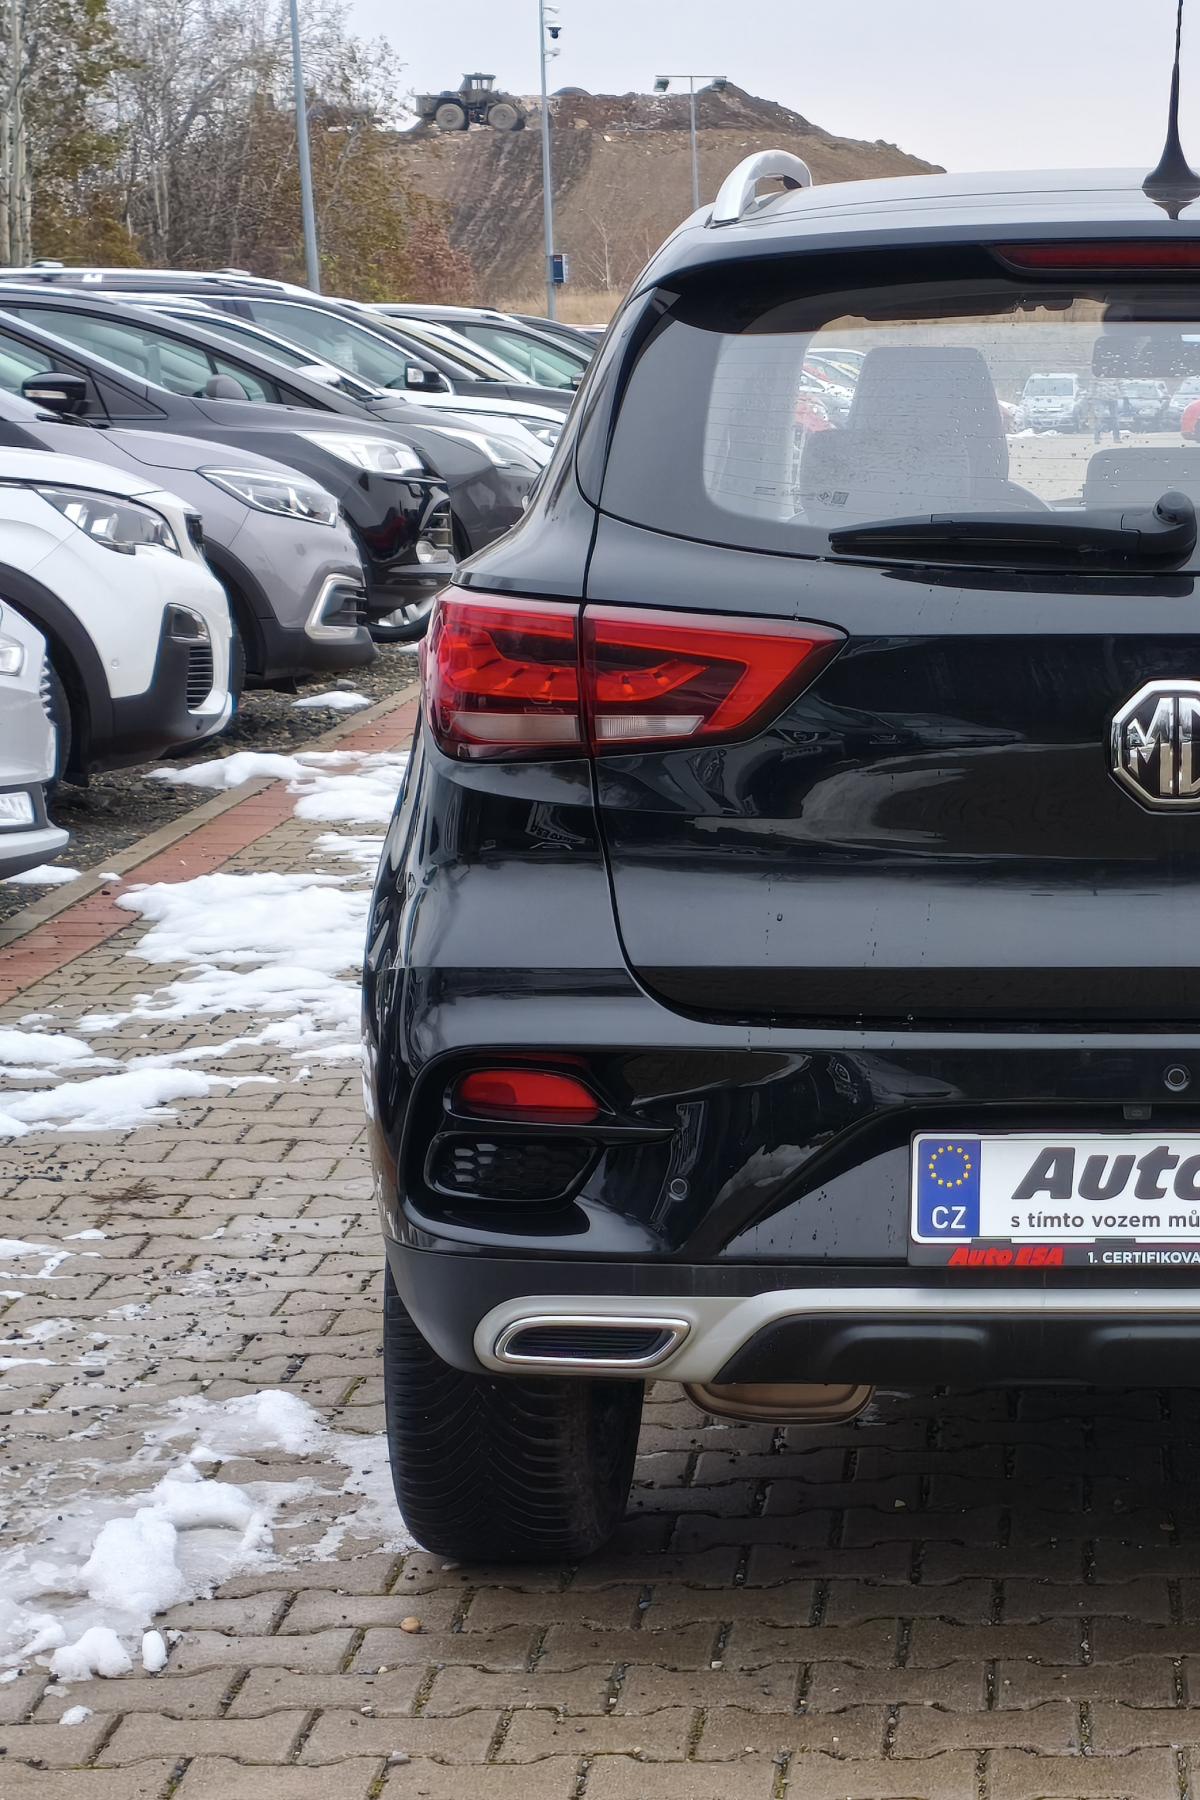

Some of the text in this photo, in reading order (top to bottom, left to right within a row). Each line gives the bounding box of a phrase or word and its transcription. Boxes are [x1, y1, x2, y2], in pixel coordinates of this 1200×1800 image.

[931, 1205, 966, 1229] CZ
[1010, 1215, 1020, 1228] s
[1028, 1211, 1085, 1228] tímto
[1092, 1214, 1161, 1228] vozem
[948, 1247, 1065, 1266] Auto ESA
[1087, 1251, 1099, 1264] 1.
